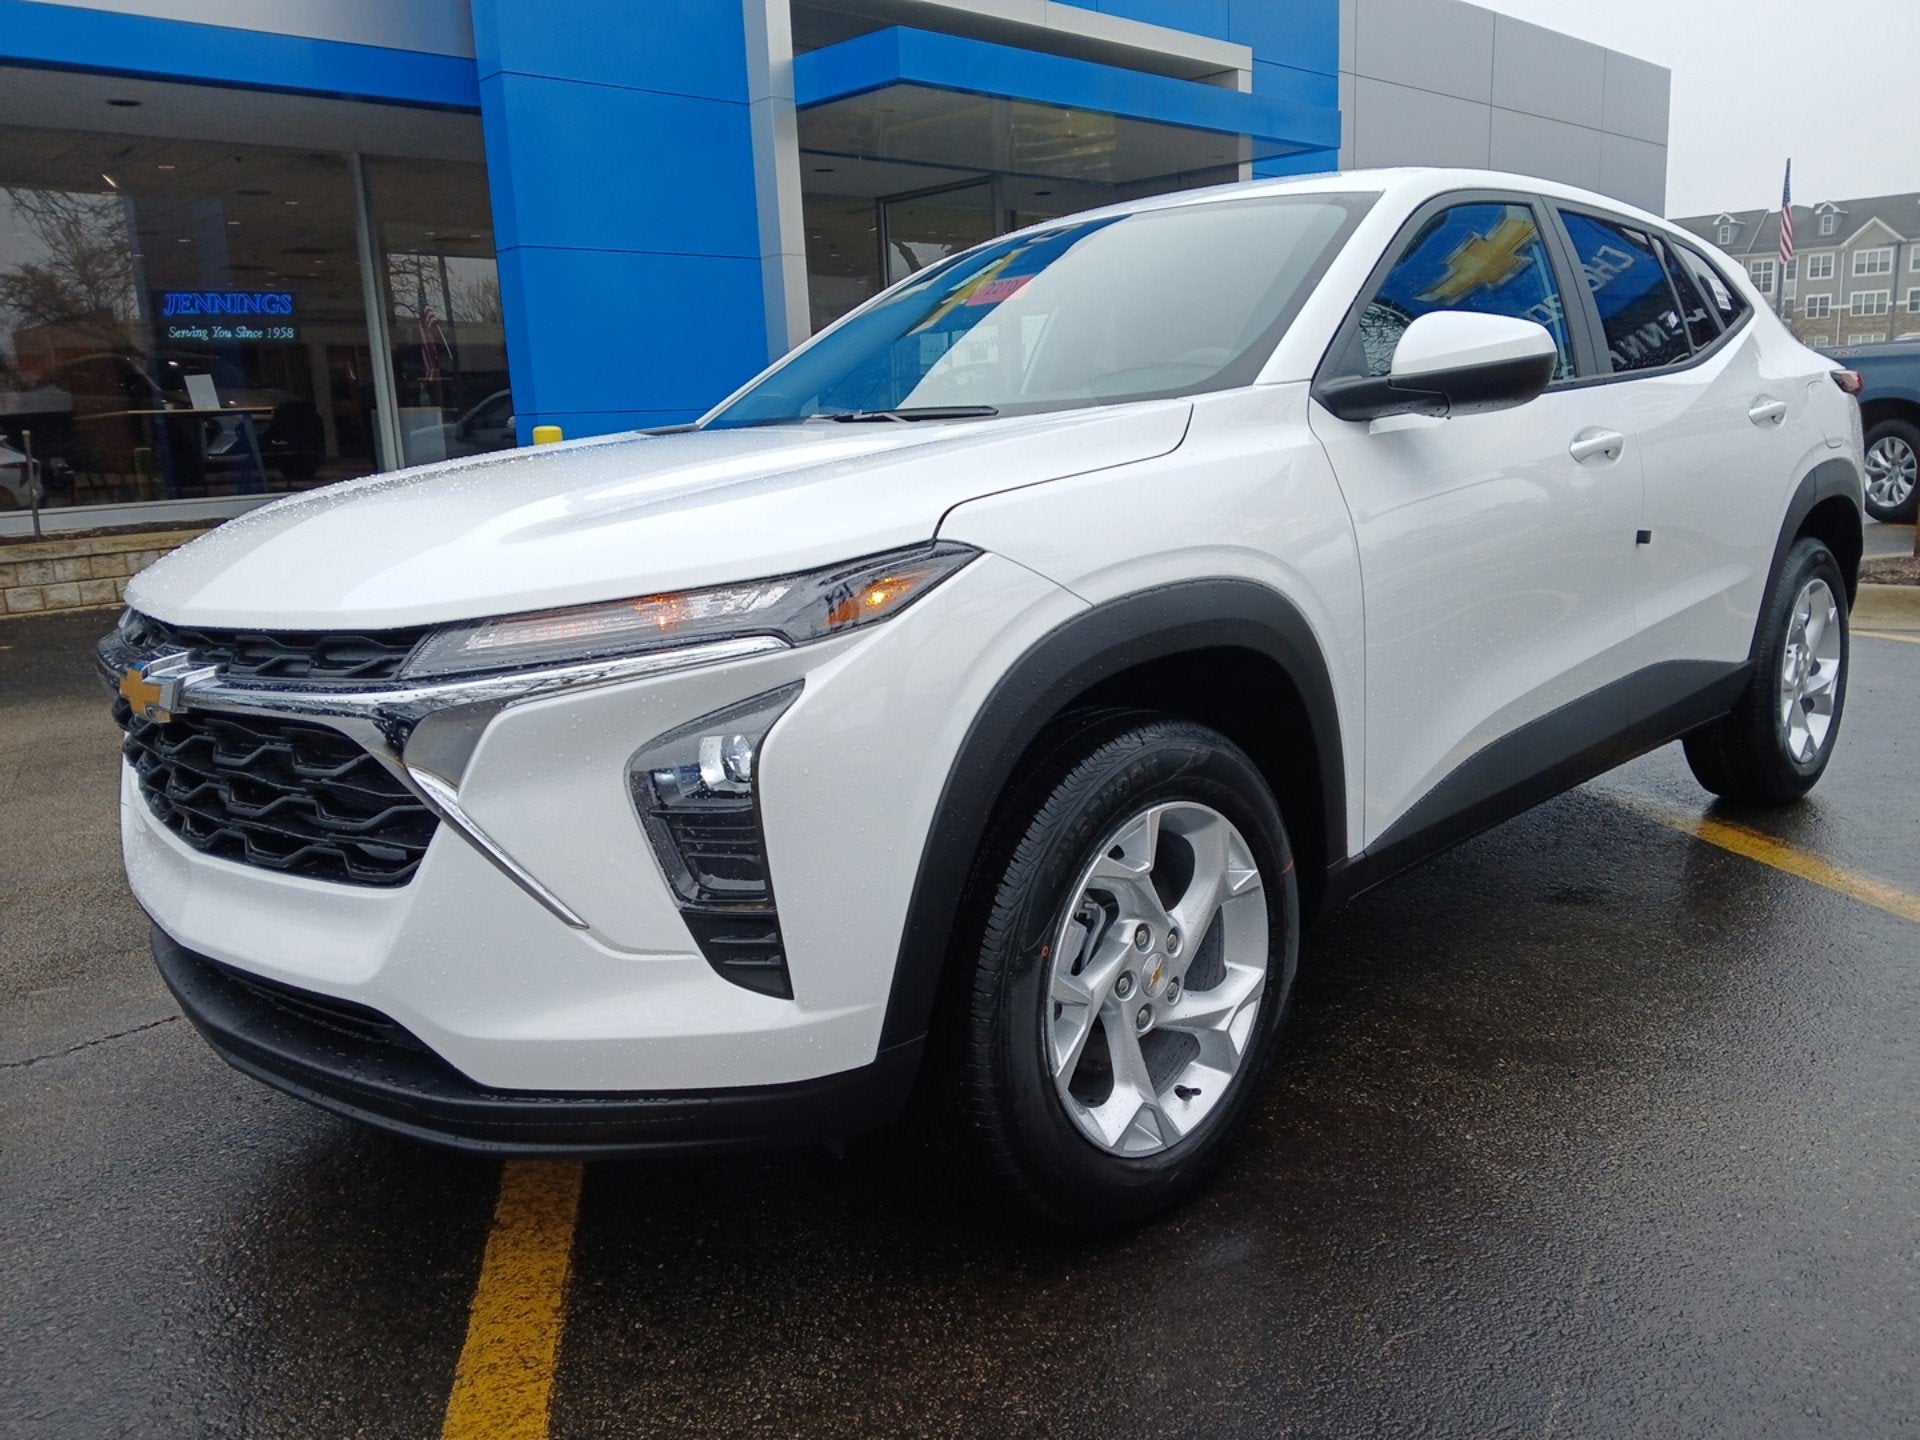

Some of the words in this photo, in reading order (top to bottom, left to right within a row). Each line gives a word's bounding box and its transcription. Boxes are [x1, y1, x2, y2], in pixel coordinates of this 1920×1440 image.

[164, 293, 293, 316] JENNINGS
[168, 326, 209, 341] Serving
[212, 326, 232, 338] You
[235, 325, 263, 338] Since
[267, 327, 294, 338] 1958
